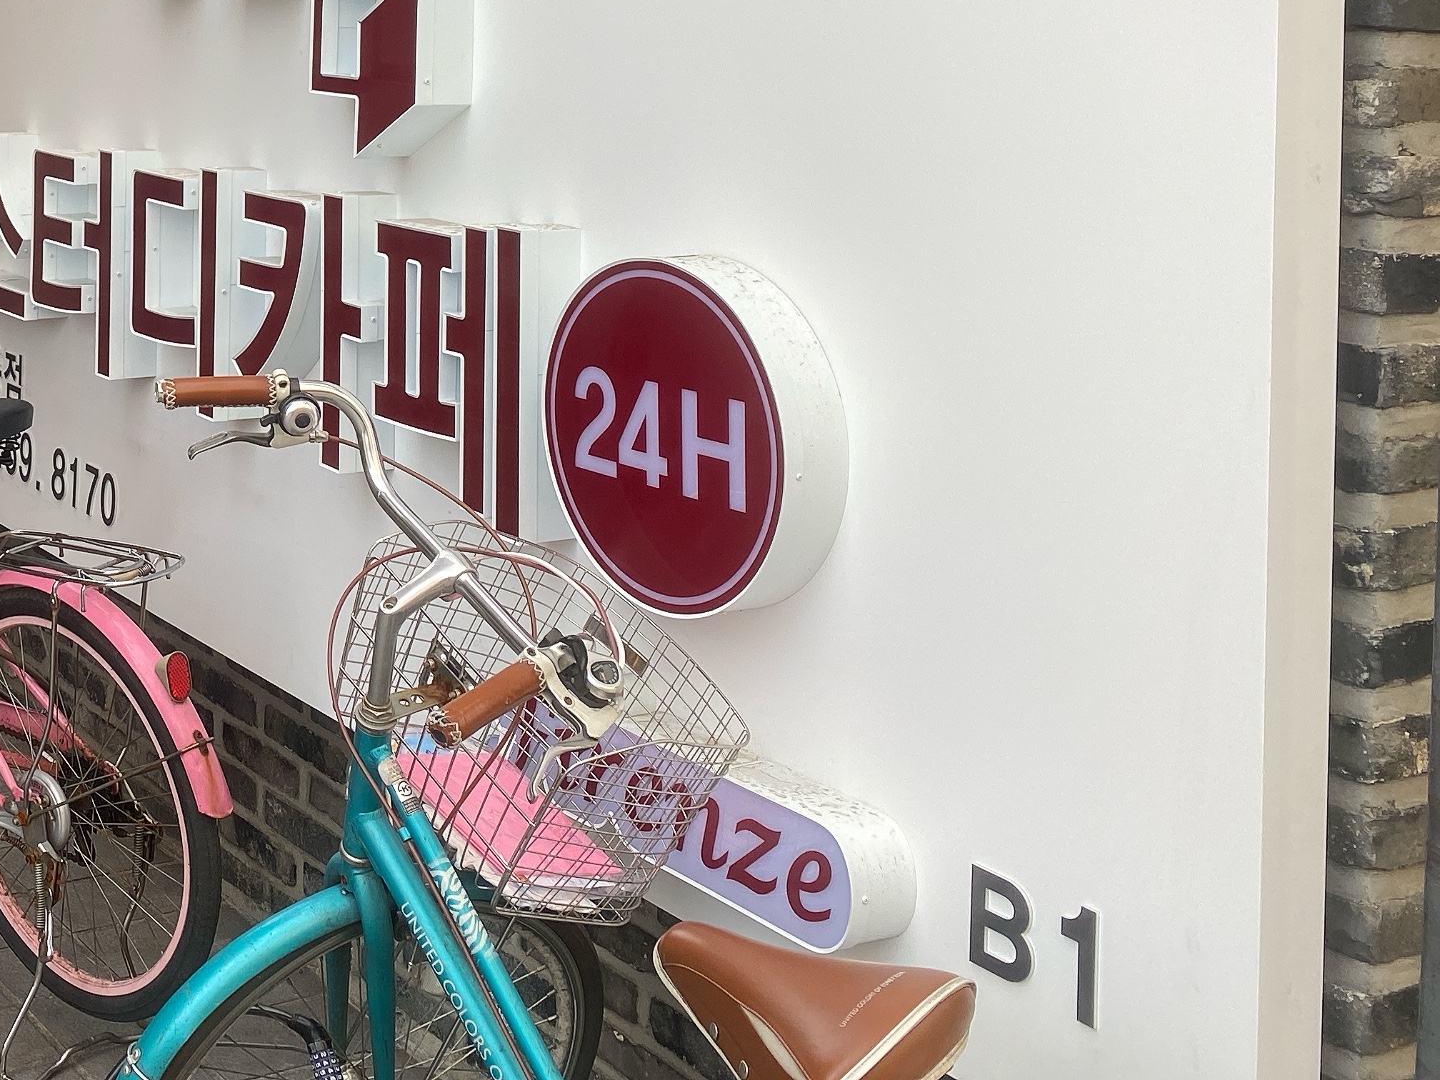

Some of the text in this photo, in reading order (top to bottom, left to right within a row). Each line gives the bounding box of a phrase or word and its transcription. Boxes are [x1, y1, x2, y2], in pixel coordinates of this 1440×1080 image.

[574, 366, 746, 513] 24H
[400, 901, 444, 976] UNITED
[443, 979, 492, 1061] COLORS
[969, 863, 1098, 1029] B1
